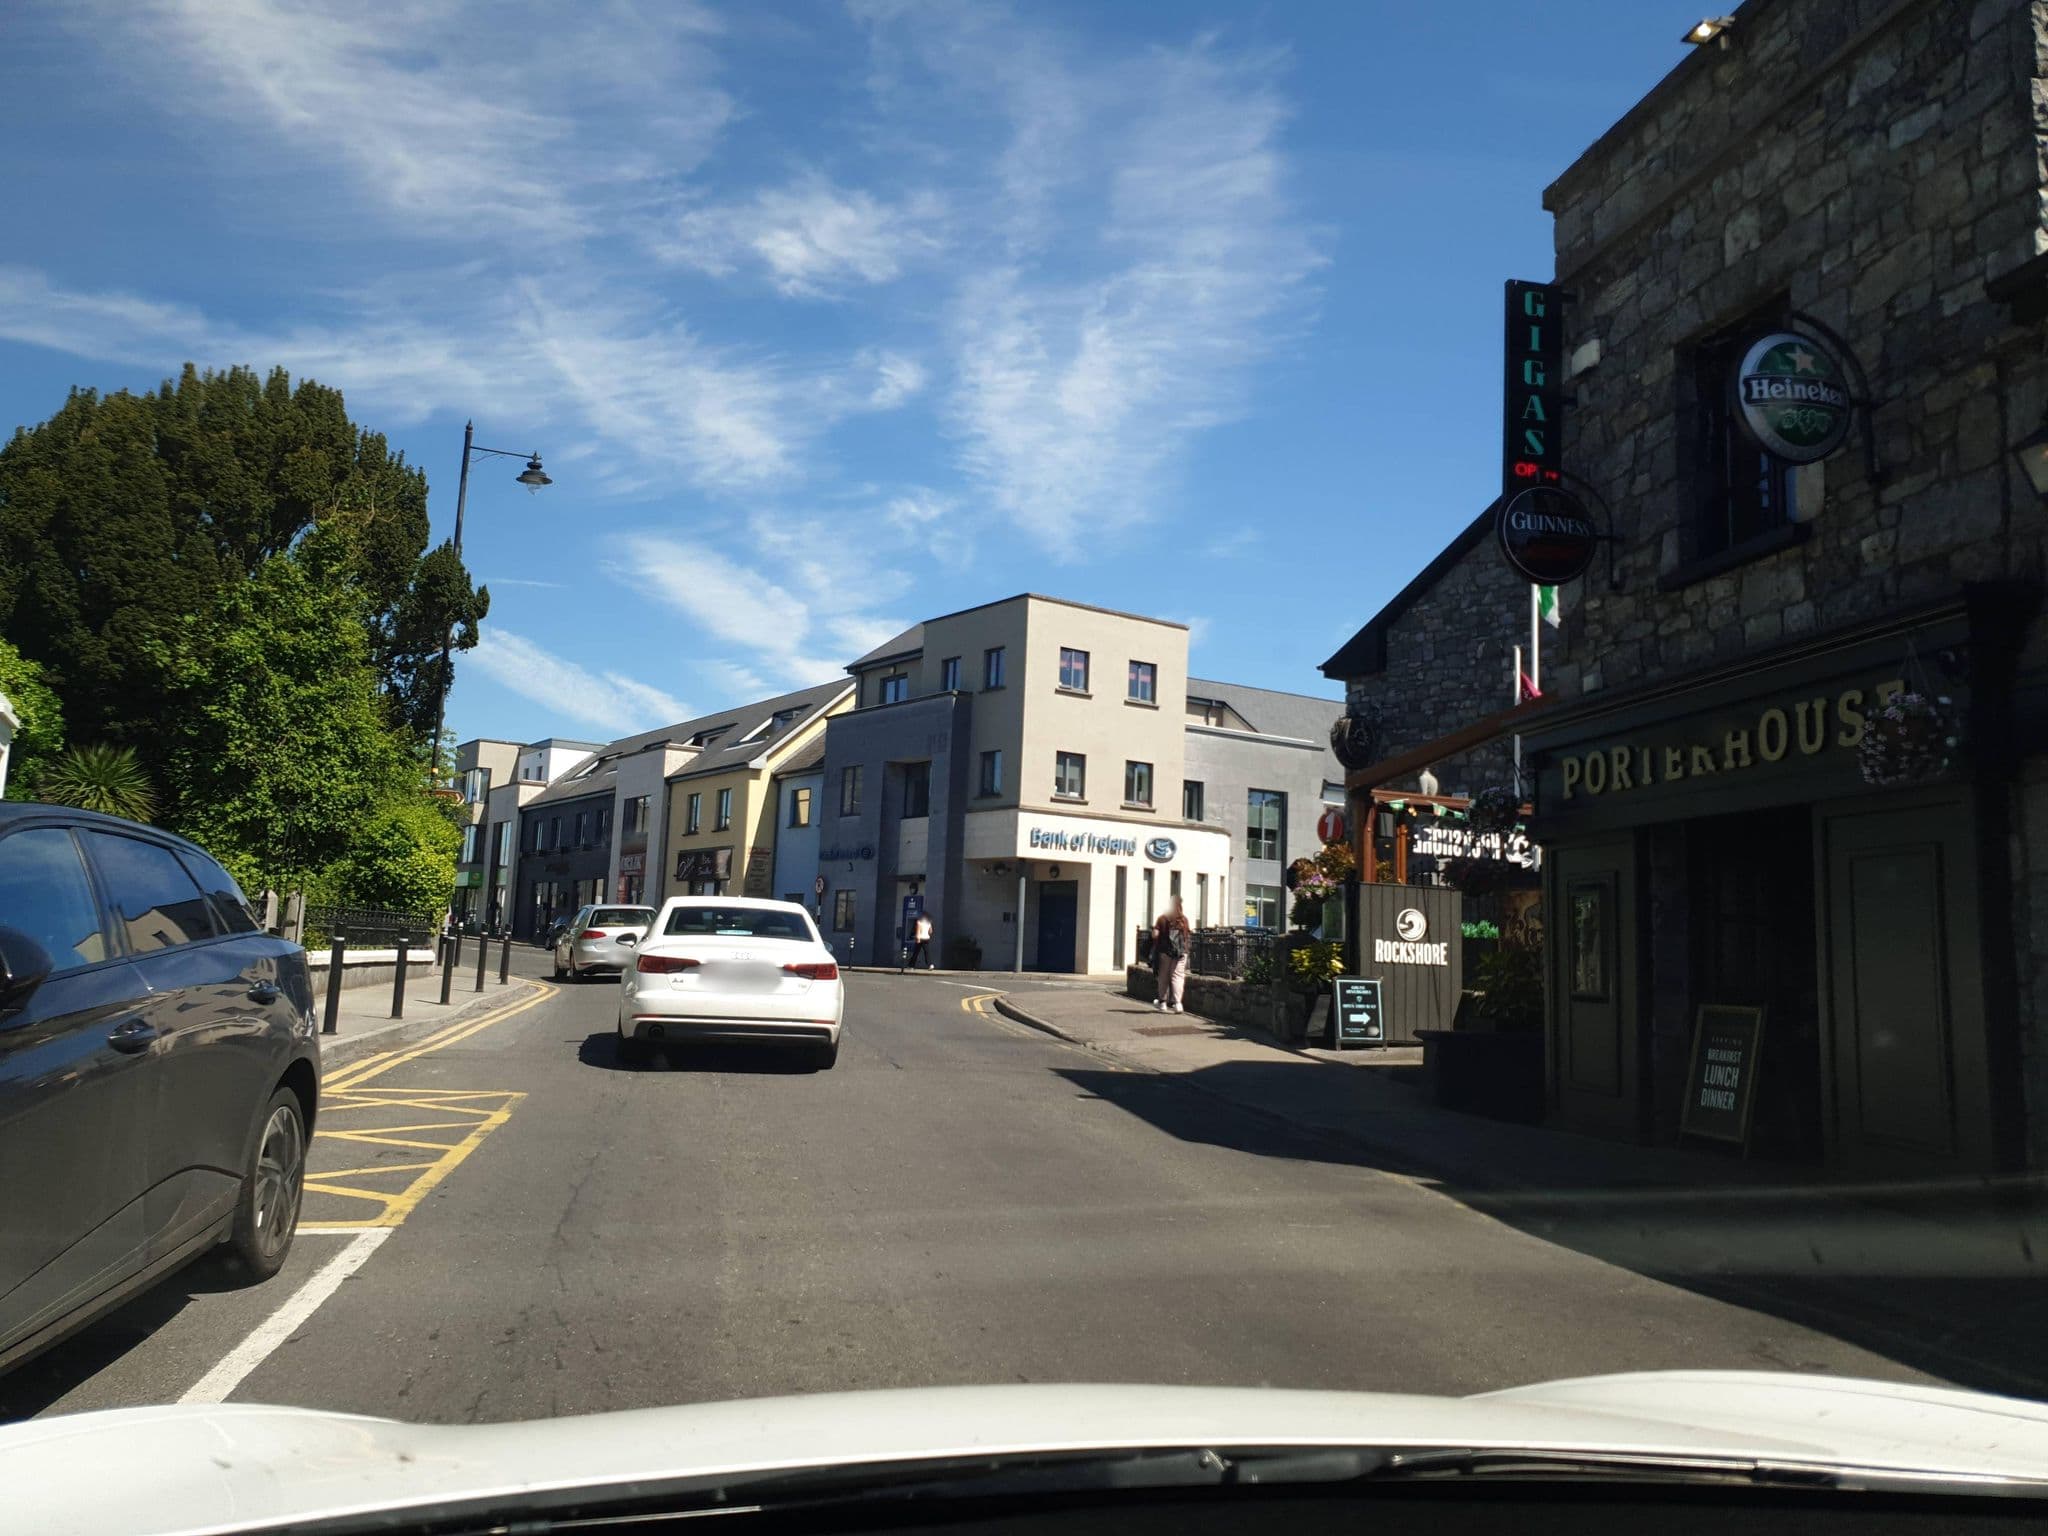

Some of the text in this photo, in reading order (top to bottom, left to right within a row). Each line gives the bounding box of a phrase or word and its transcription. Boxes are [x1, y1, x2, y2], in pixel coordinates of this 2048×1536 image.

[1523, 291, 1546, 456] GIGAS
[1511, 511, 1590, 536] GUINNESS
[1030, 827, 1136, 856] Bank of Ireland
[1375, 938, 1448, 966] ROCKSHORE
[1704, 1063, 1739, 1088] LUNCH
[1701, 1087, 1735, 1111] DINNER
